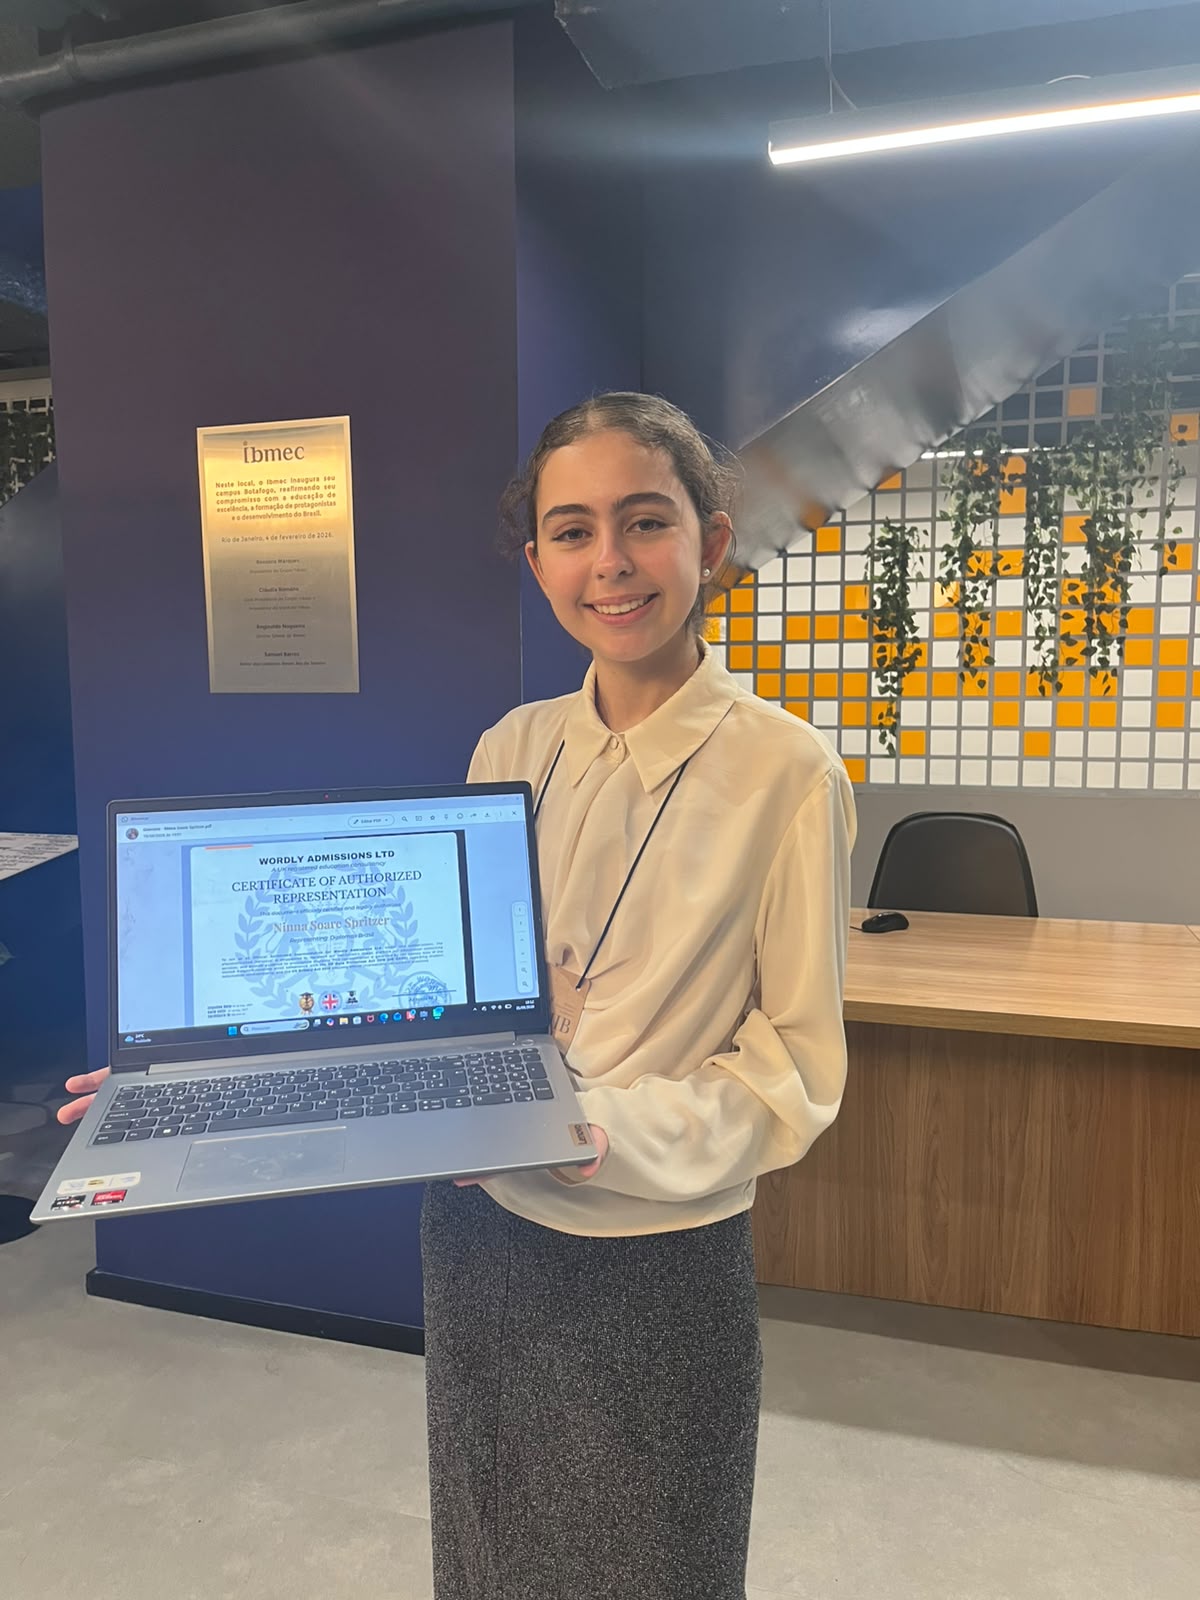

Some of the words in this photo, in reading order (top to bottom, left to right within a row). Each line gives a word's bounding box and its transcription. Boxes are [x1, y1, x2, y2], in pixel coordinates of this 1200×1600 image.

[243, 440, 305, 463] ibmec
[216, 497, 261, 505] compromisso
[294, 500, 336, 509] protagonistas
[242, 512, 292, 520] desenvolvimento
[258, 856, 304, 866] WORDLY
[307, 851, 372, 862] ADMISSIONS
[375, 850, 394, 858] LTD
[231, 877, 316, 892] CERTIFICATE
[318, 876, 336, 887] OF
[338, 870, 422, 886] AUTHORIZED
[273, 887, 387, 904] REPRESENTATION
